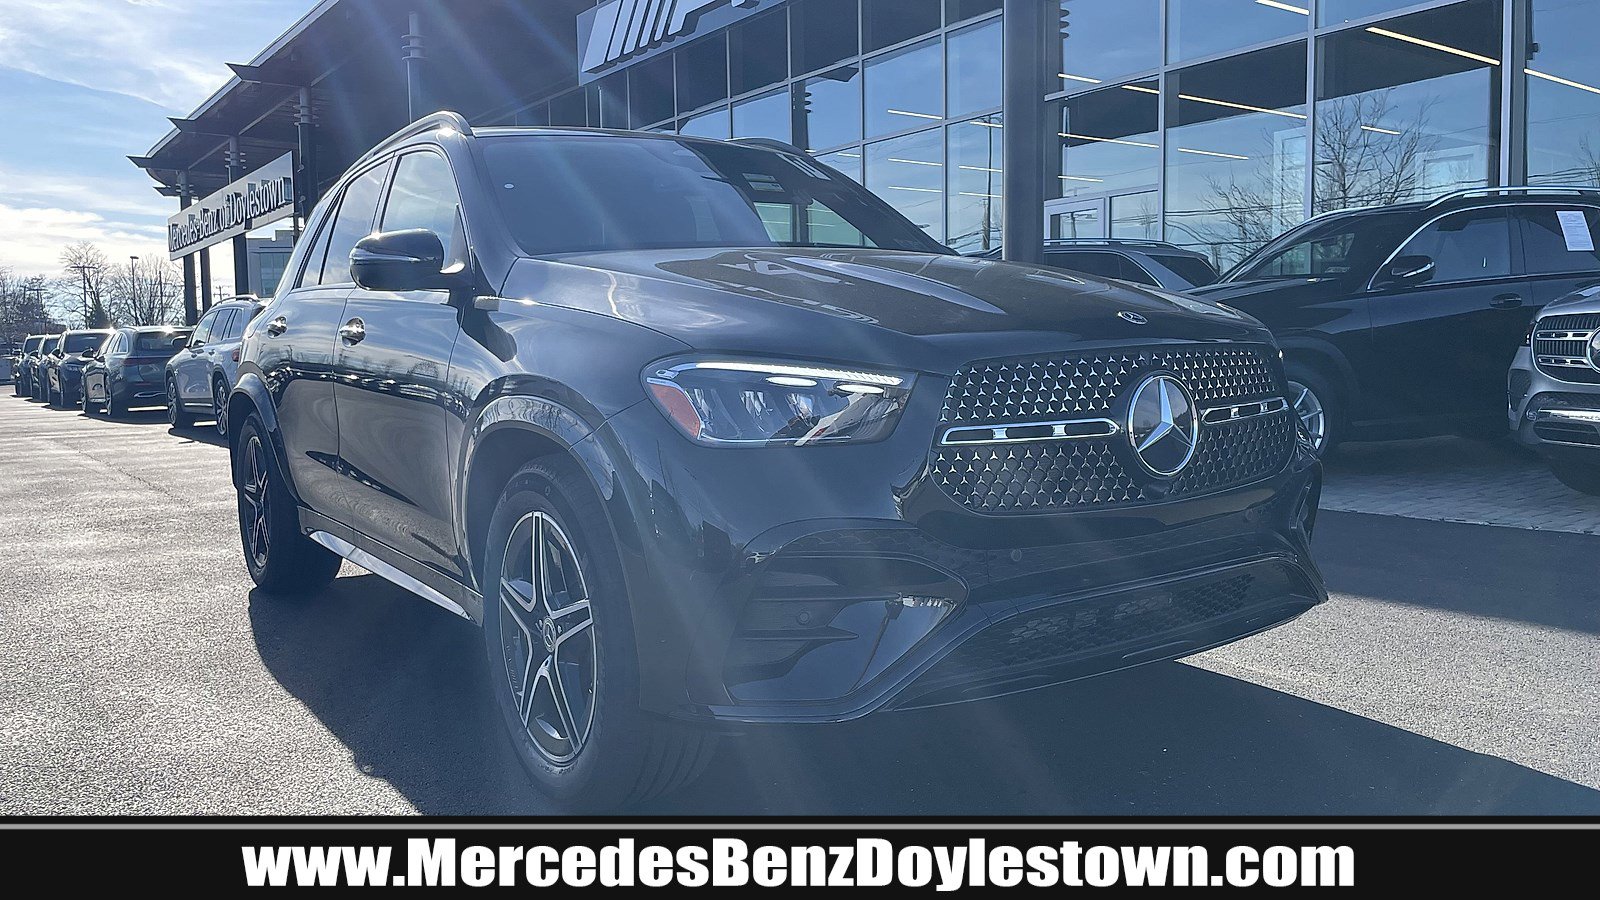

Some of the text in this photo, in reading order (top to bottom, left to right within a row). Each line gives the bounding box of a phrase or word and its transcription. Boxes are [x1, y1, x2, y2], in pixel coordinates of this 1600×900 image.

[168, 177, 287, 252] Mercedes-Benz of Doylestown
